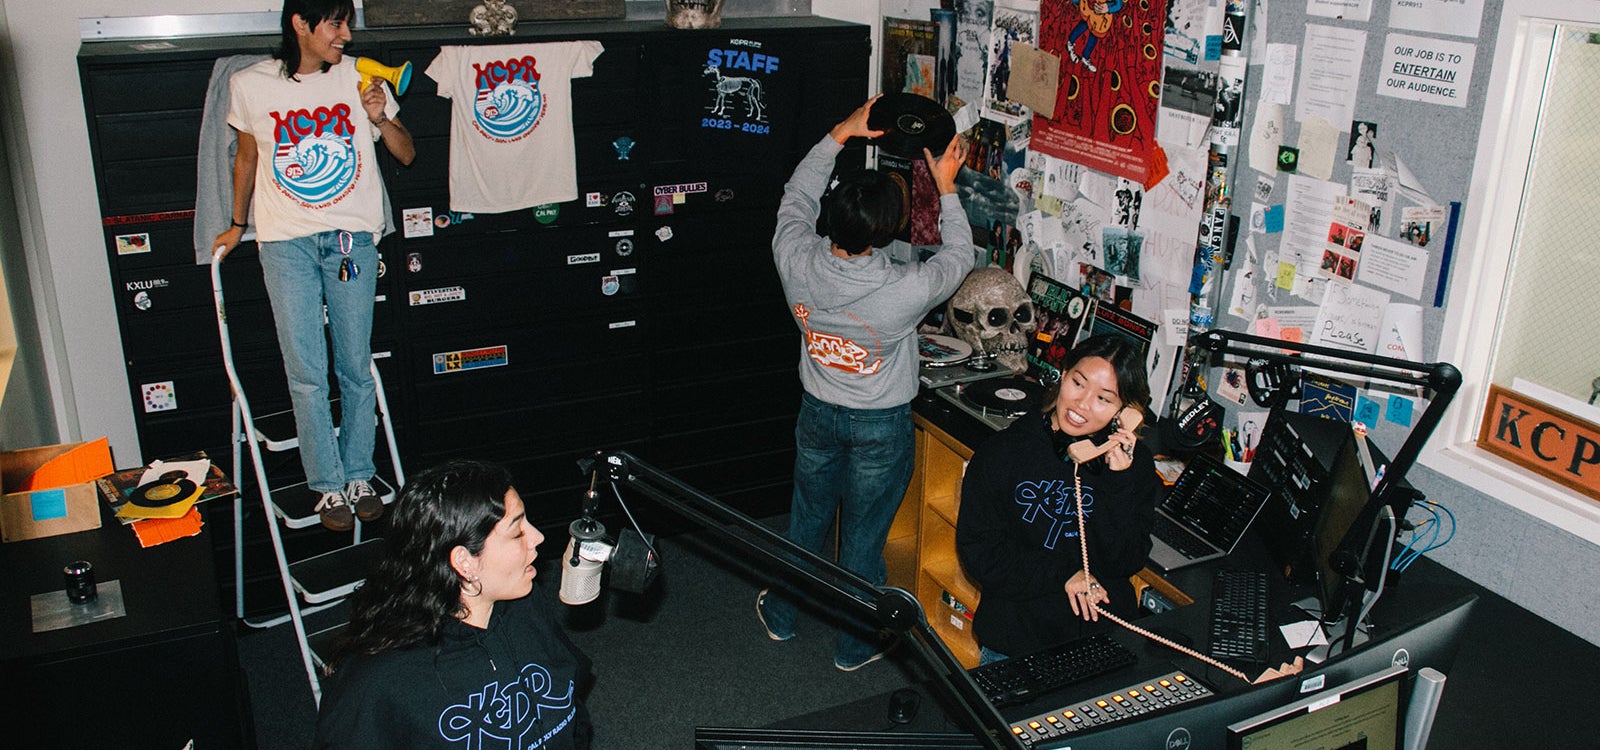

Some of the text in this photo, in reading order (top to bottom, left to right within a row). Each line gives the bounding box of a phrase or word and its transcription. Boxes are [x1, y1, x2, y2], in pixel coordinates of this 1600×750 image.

[707, 48, 780, 75] STAFF
[1394, 46, 1462, 64] OUR JOB IS TO
[472, 55, 541, 90] KCPR
[1393, 62, 1457, 82] ENTERTAIN
[1386, 78, 1457, 98] OUR AUDIENCE.
[269, 103, 356, 145] KCPR
[702, 118, 732, 130] 2023
[742, 122, 770, 135] 2024
[655, 183, 706, 195] CYBER BULLIES
[1212, 208, 1226, 253] PANGA
[126, 280, 153, 291] KXLU
[1179, 400, 1209, 429] MEDLEY
[1495, 402, 1600, 477] KCP
[1169, 737, 1189, 749] DELL
